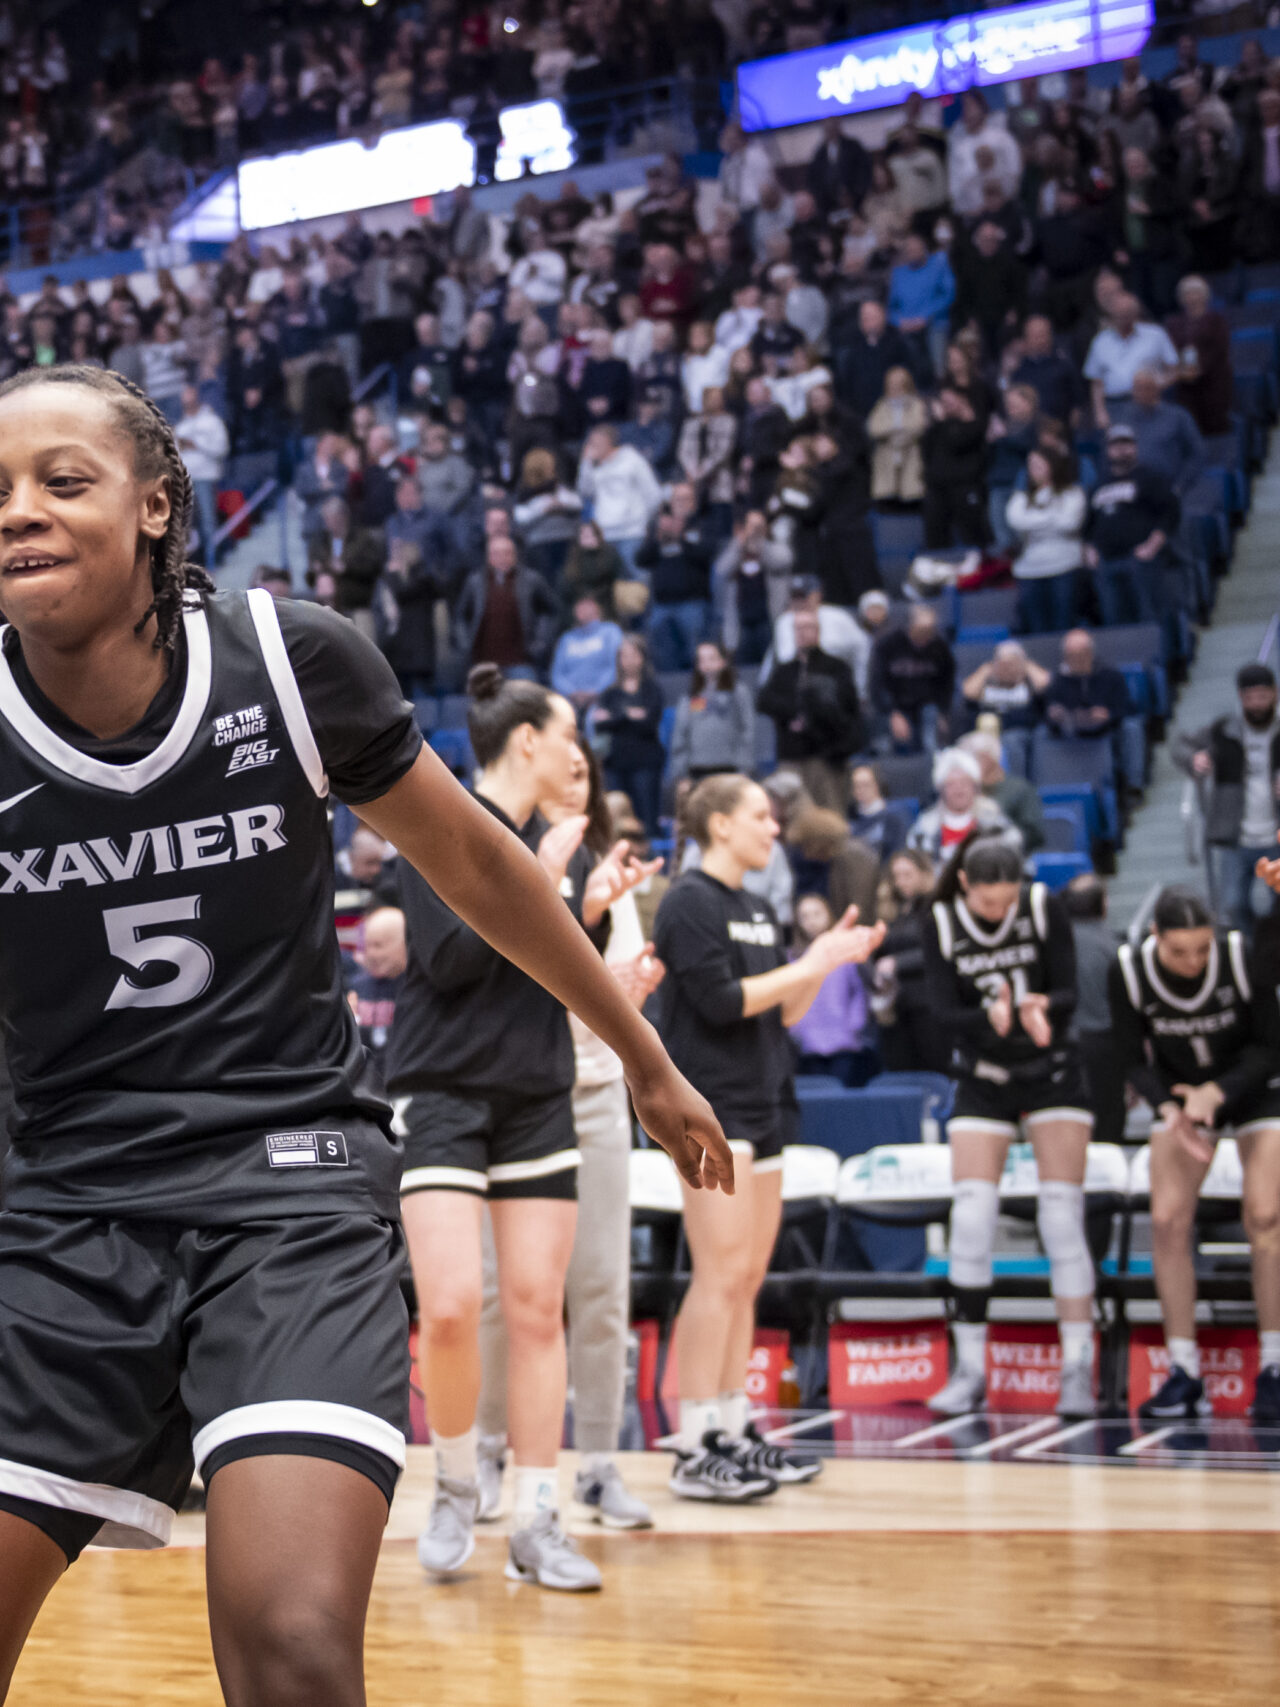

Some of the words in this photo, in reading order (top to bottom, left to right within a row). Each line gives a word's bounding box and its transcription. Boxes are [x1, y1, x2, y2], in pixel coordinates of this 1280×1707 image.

[215, 716, 235, 731] BE
[236, 705, 263, 723] THE
[214, 718, 268, 746] CHANGE
[227, 748, 280, 771] EAST
[232, 739, 269, 759] BIG
[103, 894, 215, 1012] 5
[1190, 1036, 1213, 1067] 1
[326, 1140, 338, 1156] S
[846, 1334, 933, 1361] WELLS
[989, 1344, 1062, 1366] WELL
[847, 1357, 934, 1387] FARGO
[990, 1367, 1061, 1394] FARG
